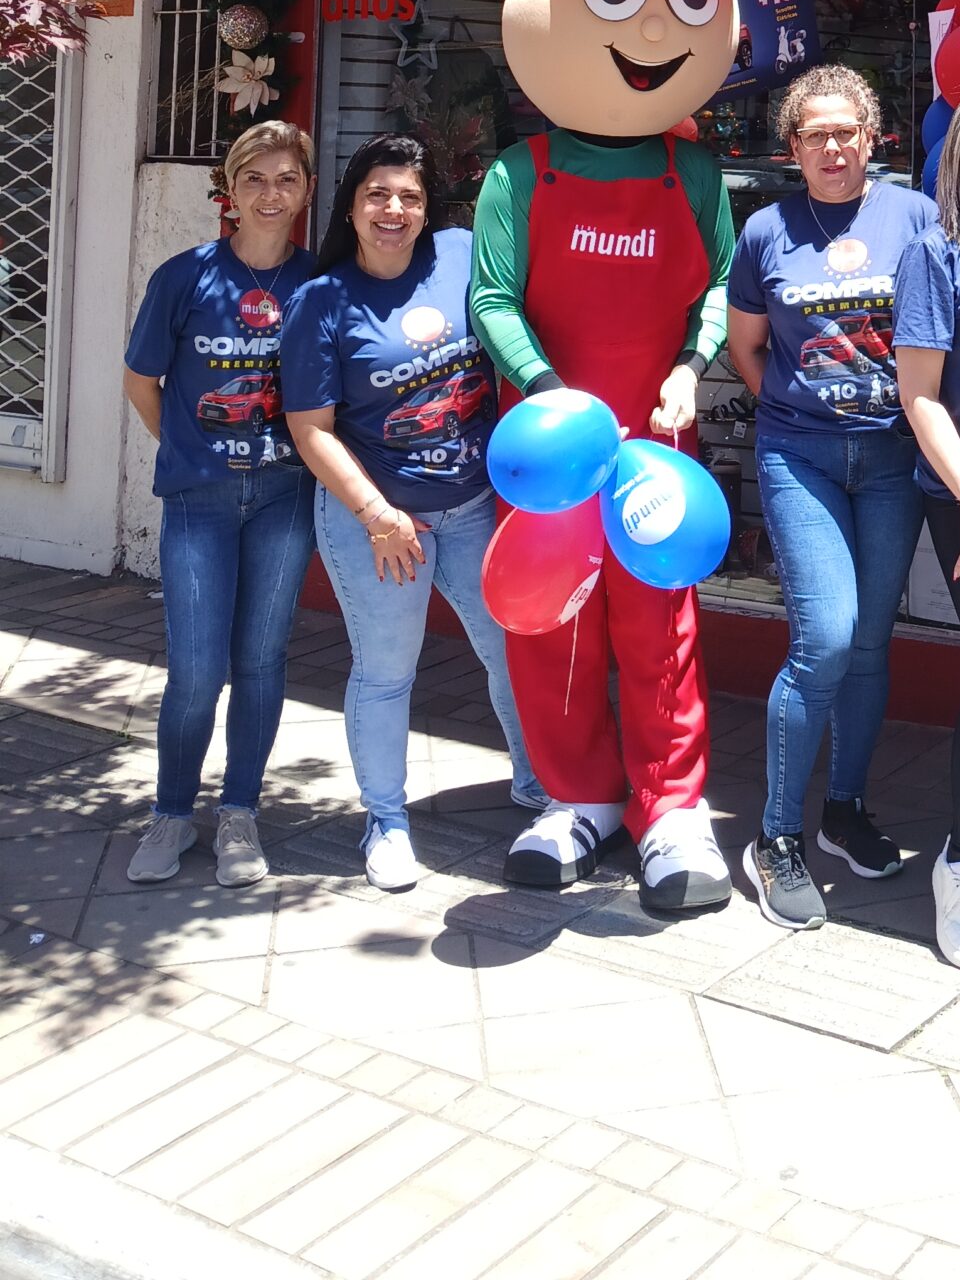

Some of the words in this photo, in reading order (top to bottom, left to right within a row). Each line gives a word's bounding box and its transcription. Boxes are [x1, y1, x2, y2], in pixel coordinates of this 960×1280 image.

[570, 228, 656, 258] mundi
[782, 275, 896, 306] COMPR
[817, 382, 858, 402] +10
[212, 439, 250, 456] +10
[408, 448, 448, 463] +10
